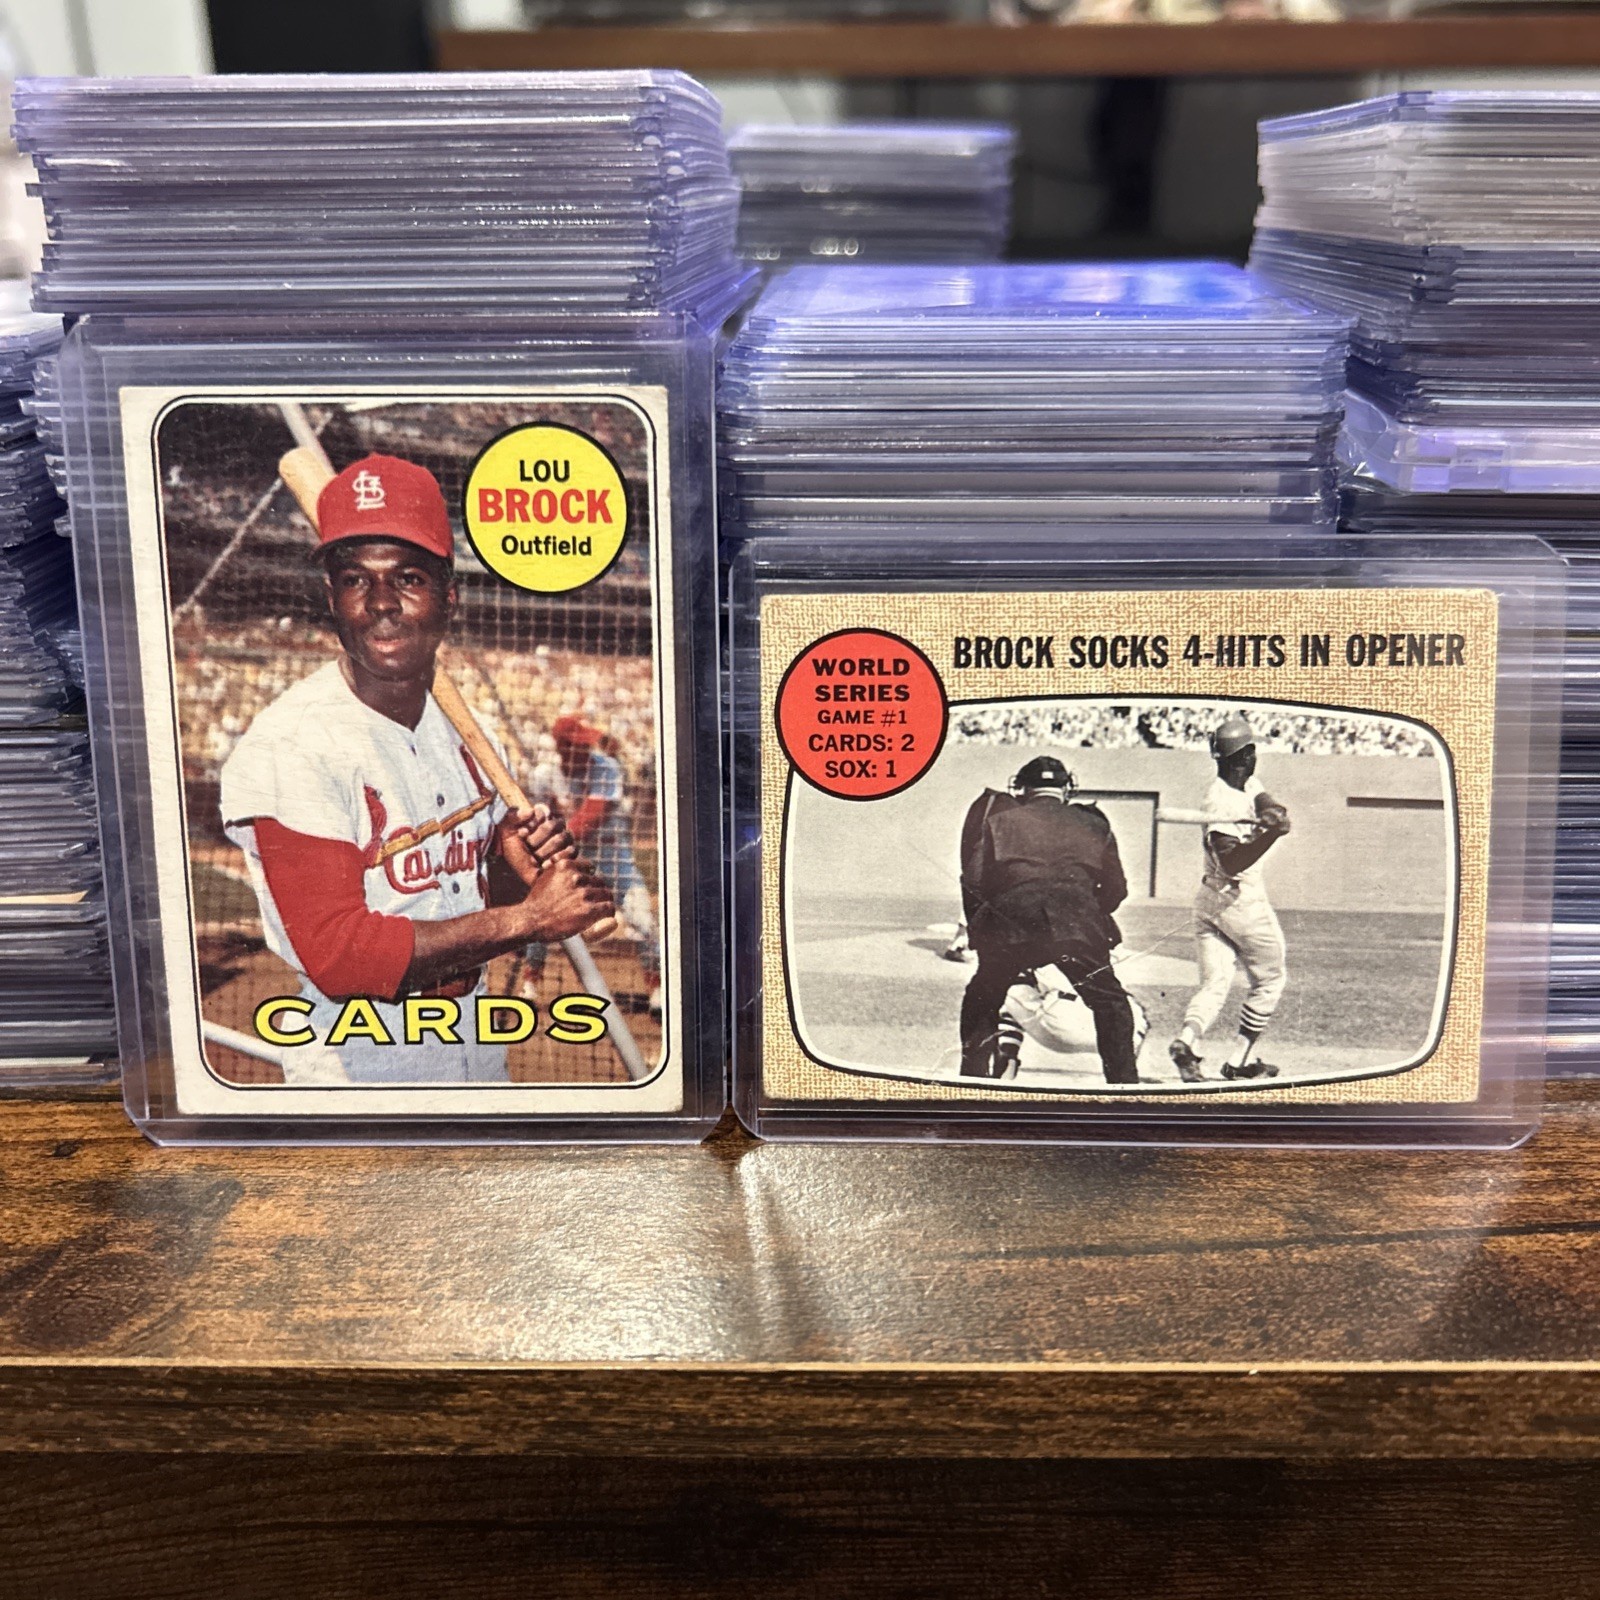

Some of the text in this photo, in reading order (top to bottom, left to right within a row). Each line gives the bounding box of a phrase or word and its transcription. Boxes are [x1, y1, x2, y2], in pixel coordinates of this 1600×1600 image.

[519, 460, 570, 483] LOU
[478, 488, 613, 524] BROCK
[501, 535, 592, 556] Outfield
[954, 633, 1466, 669] BROCK SOCKS 4-HITS IN OPENER
[812, 658, 911, 676] WORLD
[815, 685, 911, 702] SERIES
[817, 710, 907, 727] GAME #1
[808, 734, 915, 752] CARDS: 2
[825, 760, 897, 778] SOX: 1
[253, 993, 611, 1047] CARDS
